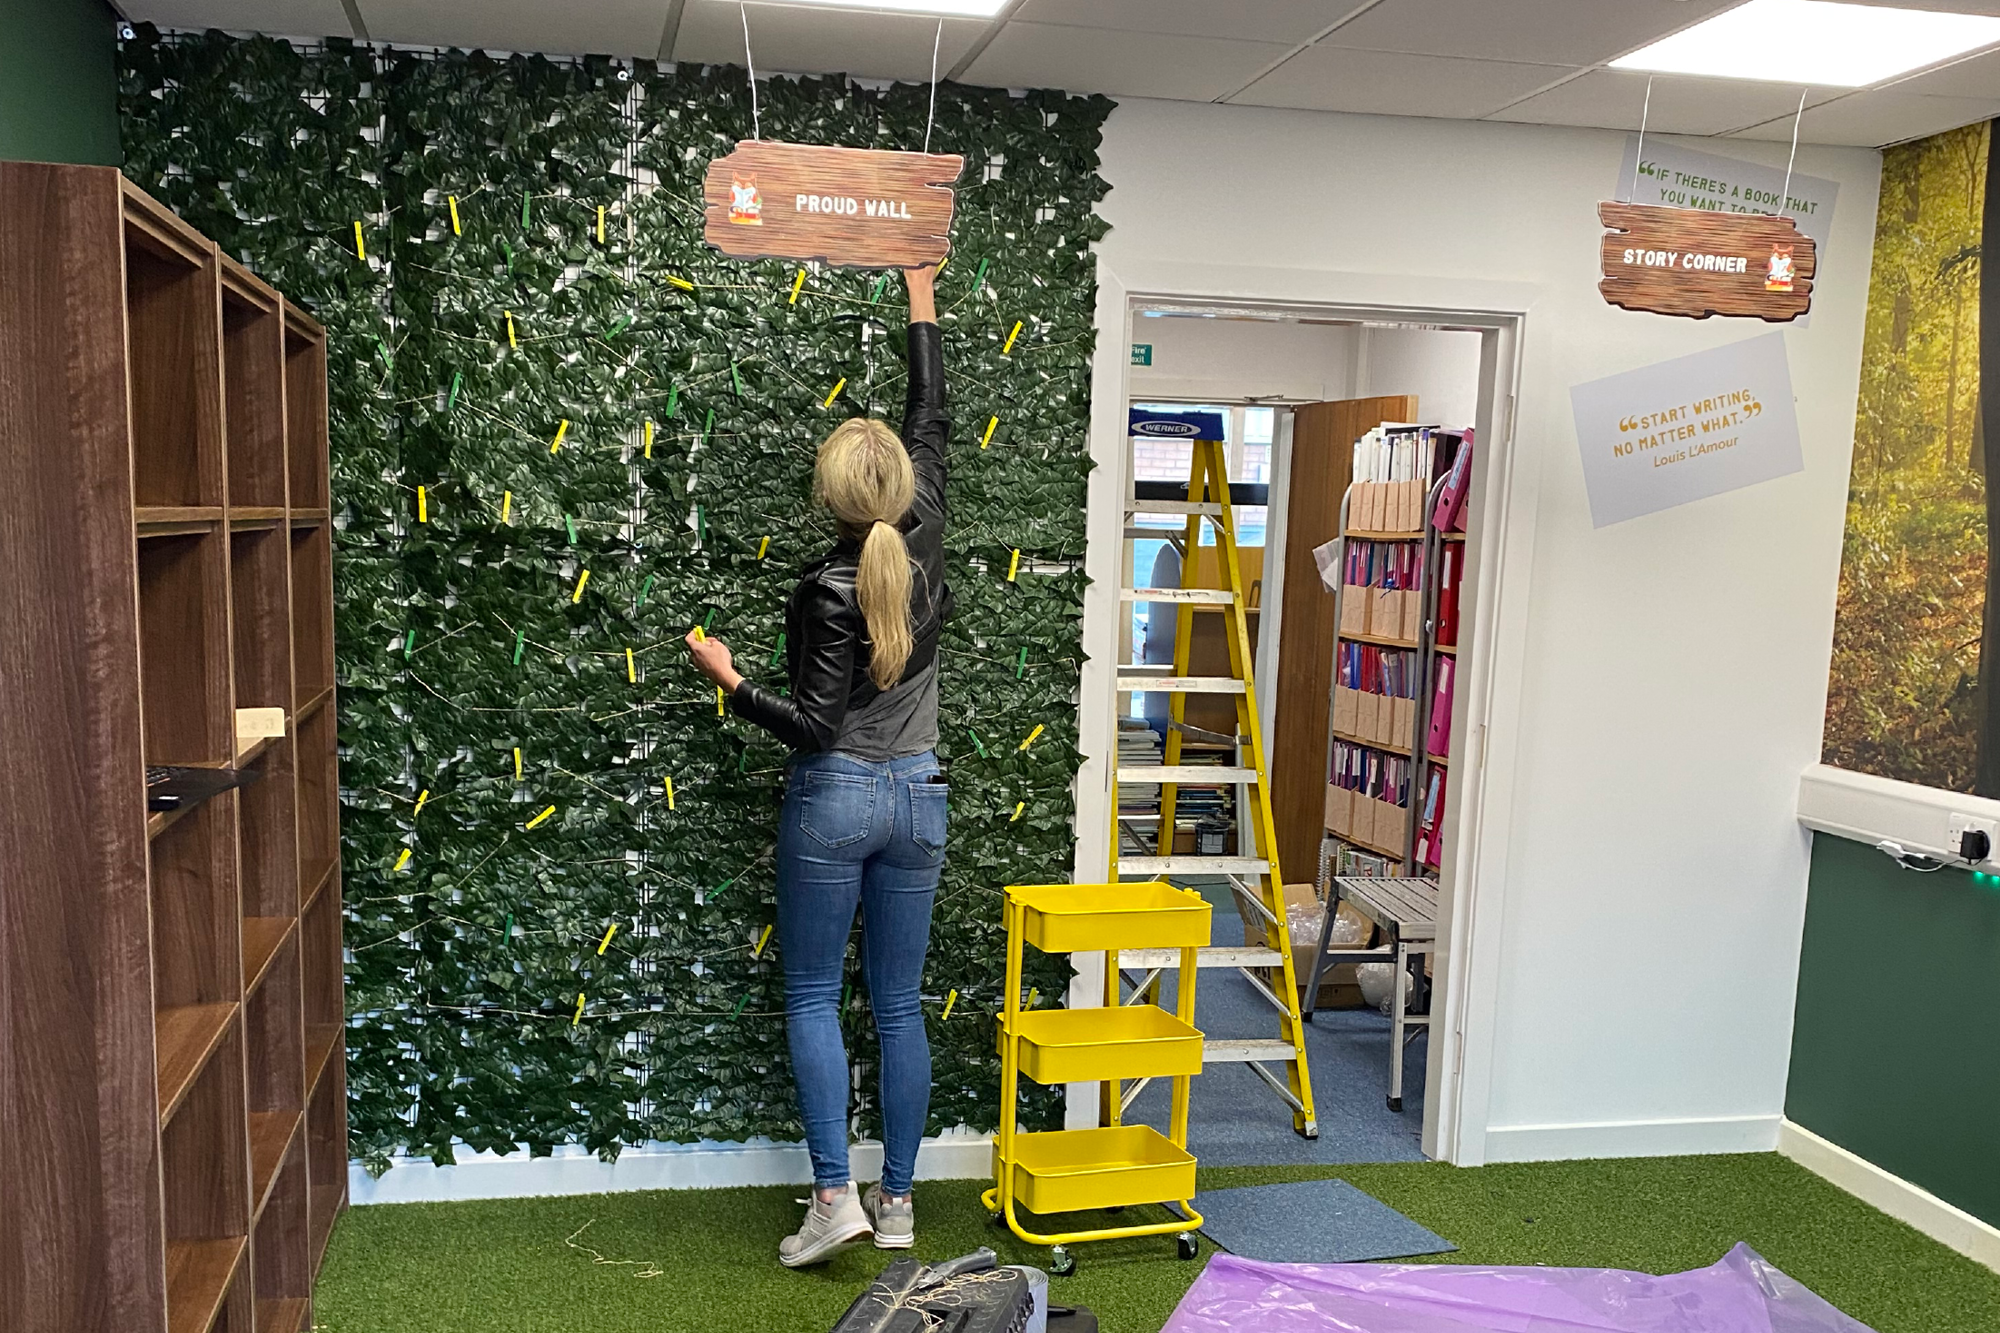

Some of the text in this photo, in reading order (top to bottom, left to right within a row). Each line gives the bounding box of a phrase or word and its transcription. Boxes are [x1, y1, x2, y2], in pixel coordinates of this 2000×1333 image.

[795, 193, 912, 219] PROUD WALL
[1660, 188, 1686, 205] YOU
[1691, 194, 1726, 212] WANT
[1674, 171, 1727, 194] THERE'S
[1731, 185, 1739, 198] A
[1744, 187, 1780, 206] BOOK
[1785, 196, 1818, 214] THAT
[1623, 248, 1748, 274] STORY CORNER
[1692, 388, 1756, 416] WRITING,
[1145, 424, 1188, 433] WERNER
[1613, 441, 1634, 458] NO
[1638, 423, 1697, 451] MATTER
[1654, 436, 1740, 468] Louis L'Amour
